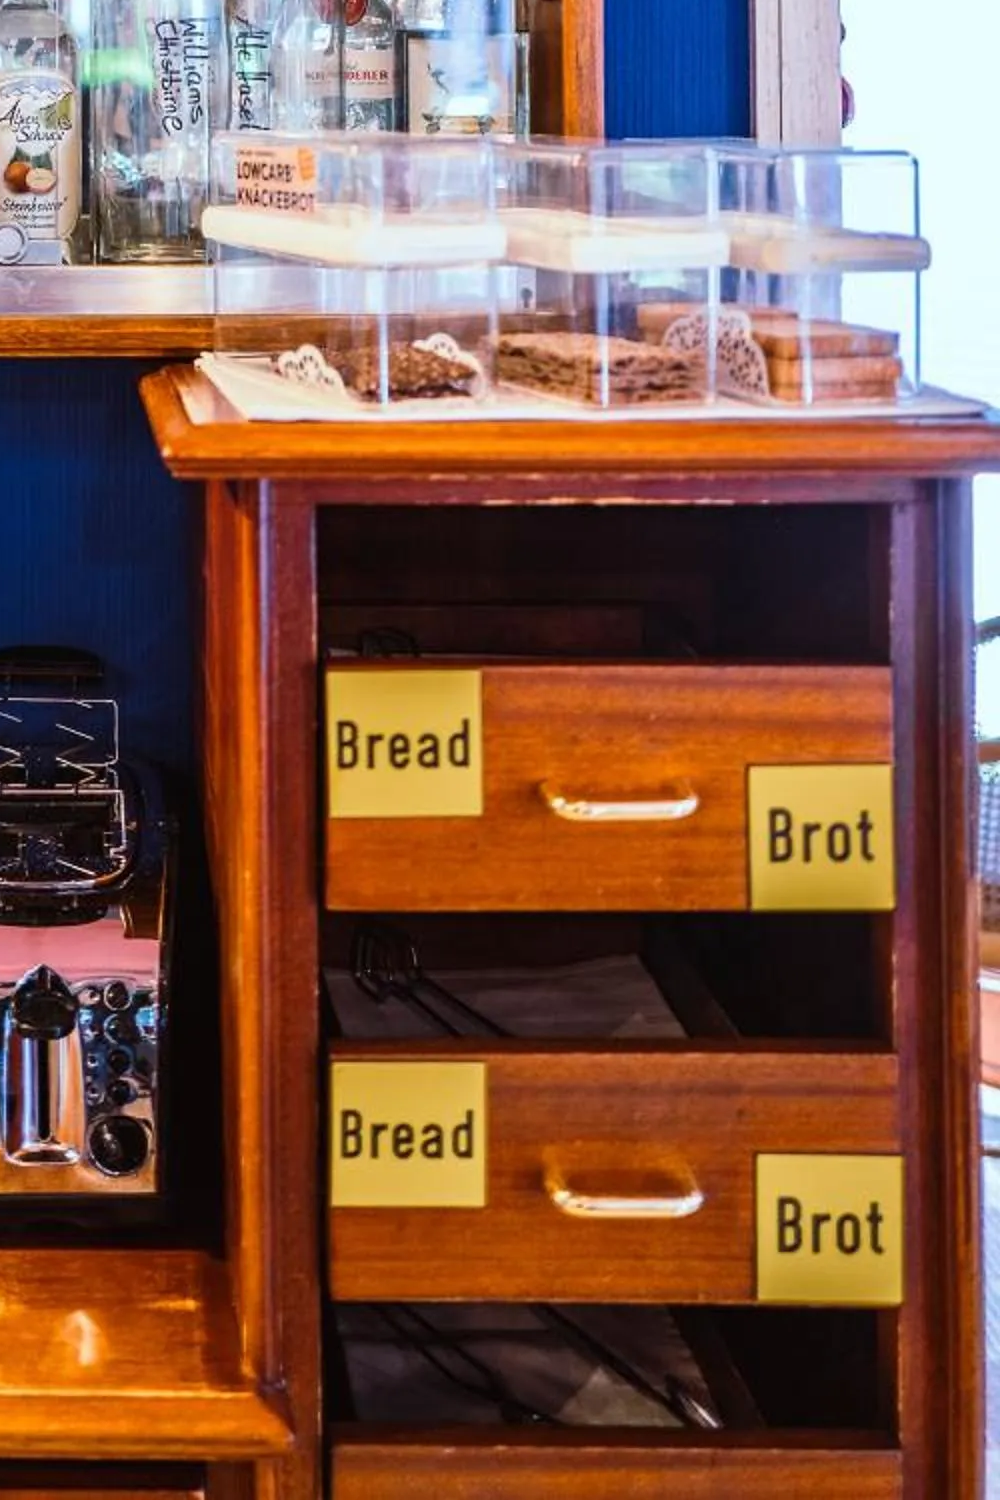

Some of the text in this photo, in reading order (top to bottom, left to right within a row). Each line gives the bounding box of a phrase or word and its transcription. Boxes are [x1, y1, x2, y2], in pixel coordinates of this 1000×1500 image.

[178, 17, 214, 125] Williams
[336, 718, 471, 770] Bread
[768, 807, 875, 863] Brot
[340, 1109, 474, 1159] Bread
[776, 1196, 885, 1255] Brot
